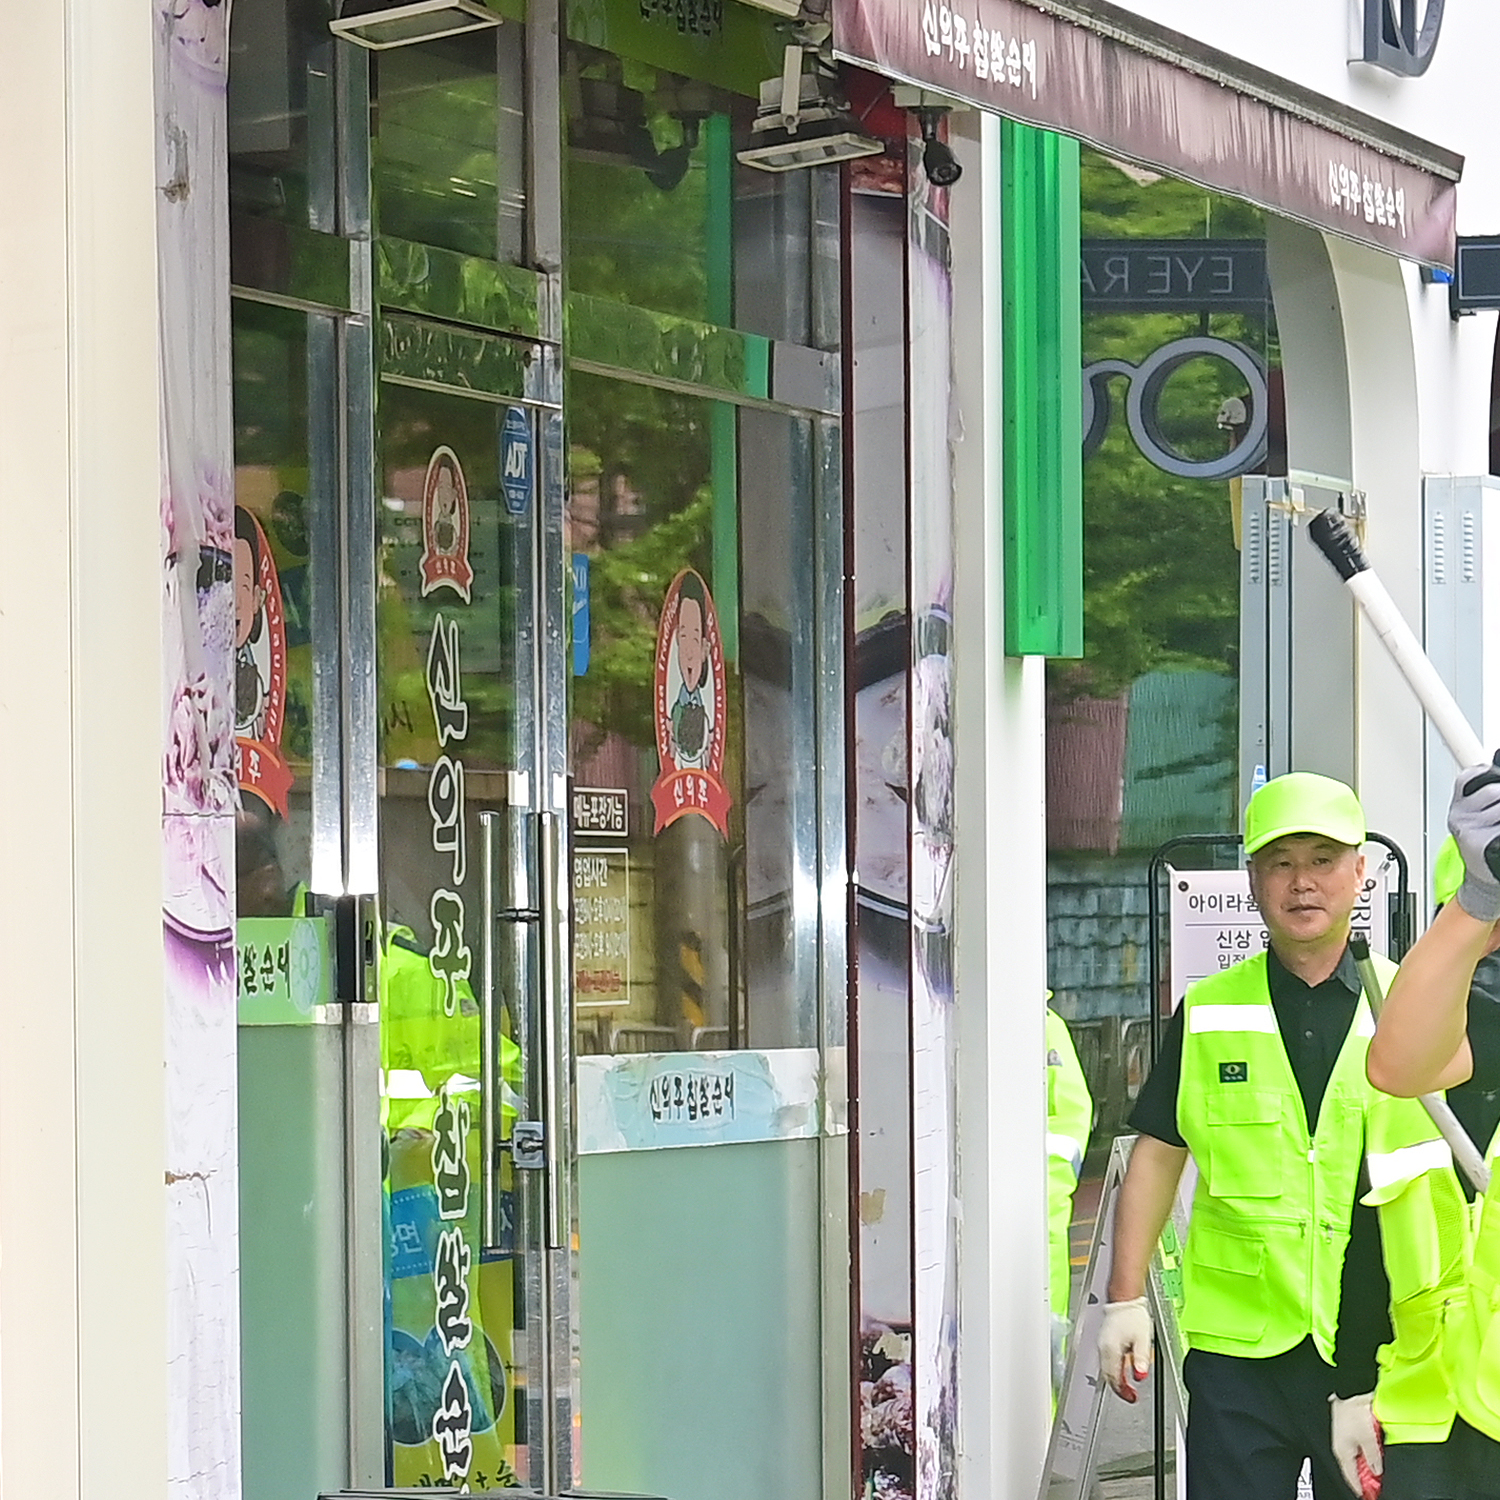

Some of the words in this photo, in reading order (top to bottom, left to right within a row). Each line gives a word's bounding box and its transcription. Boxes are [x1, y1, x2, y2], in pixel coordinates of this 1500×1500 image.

[504, 441, 528, 479] ADT
[427, 612, 472, 1018] 신의주
[1216, 930, 1252, 950] 신상
[237, 940, 291, 1000] 쌀순대
